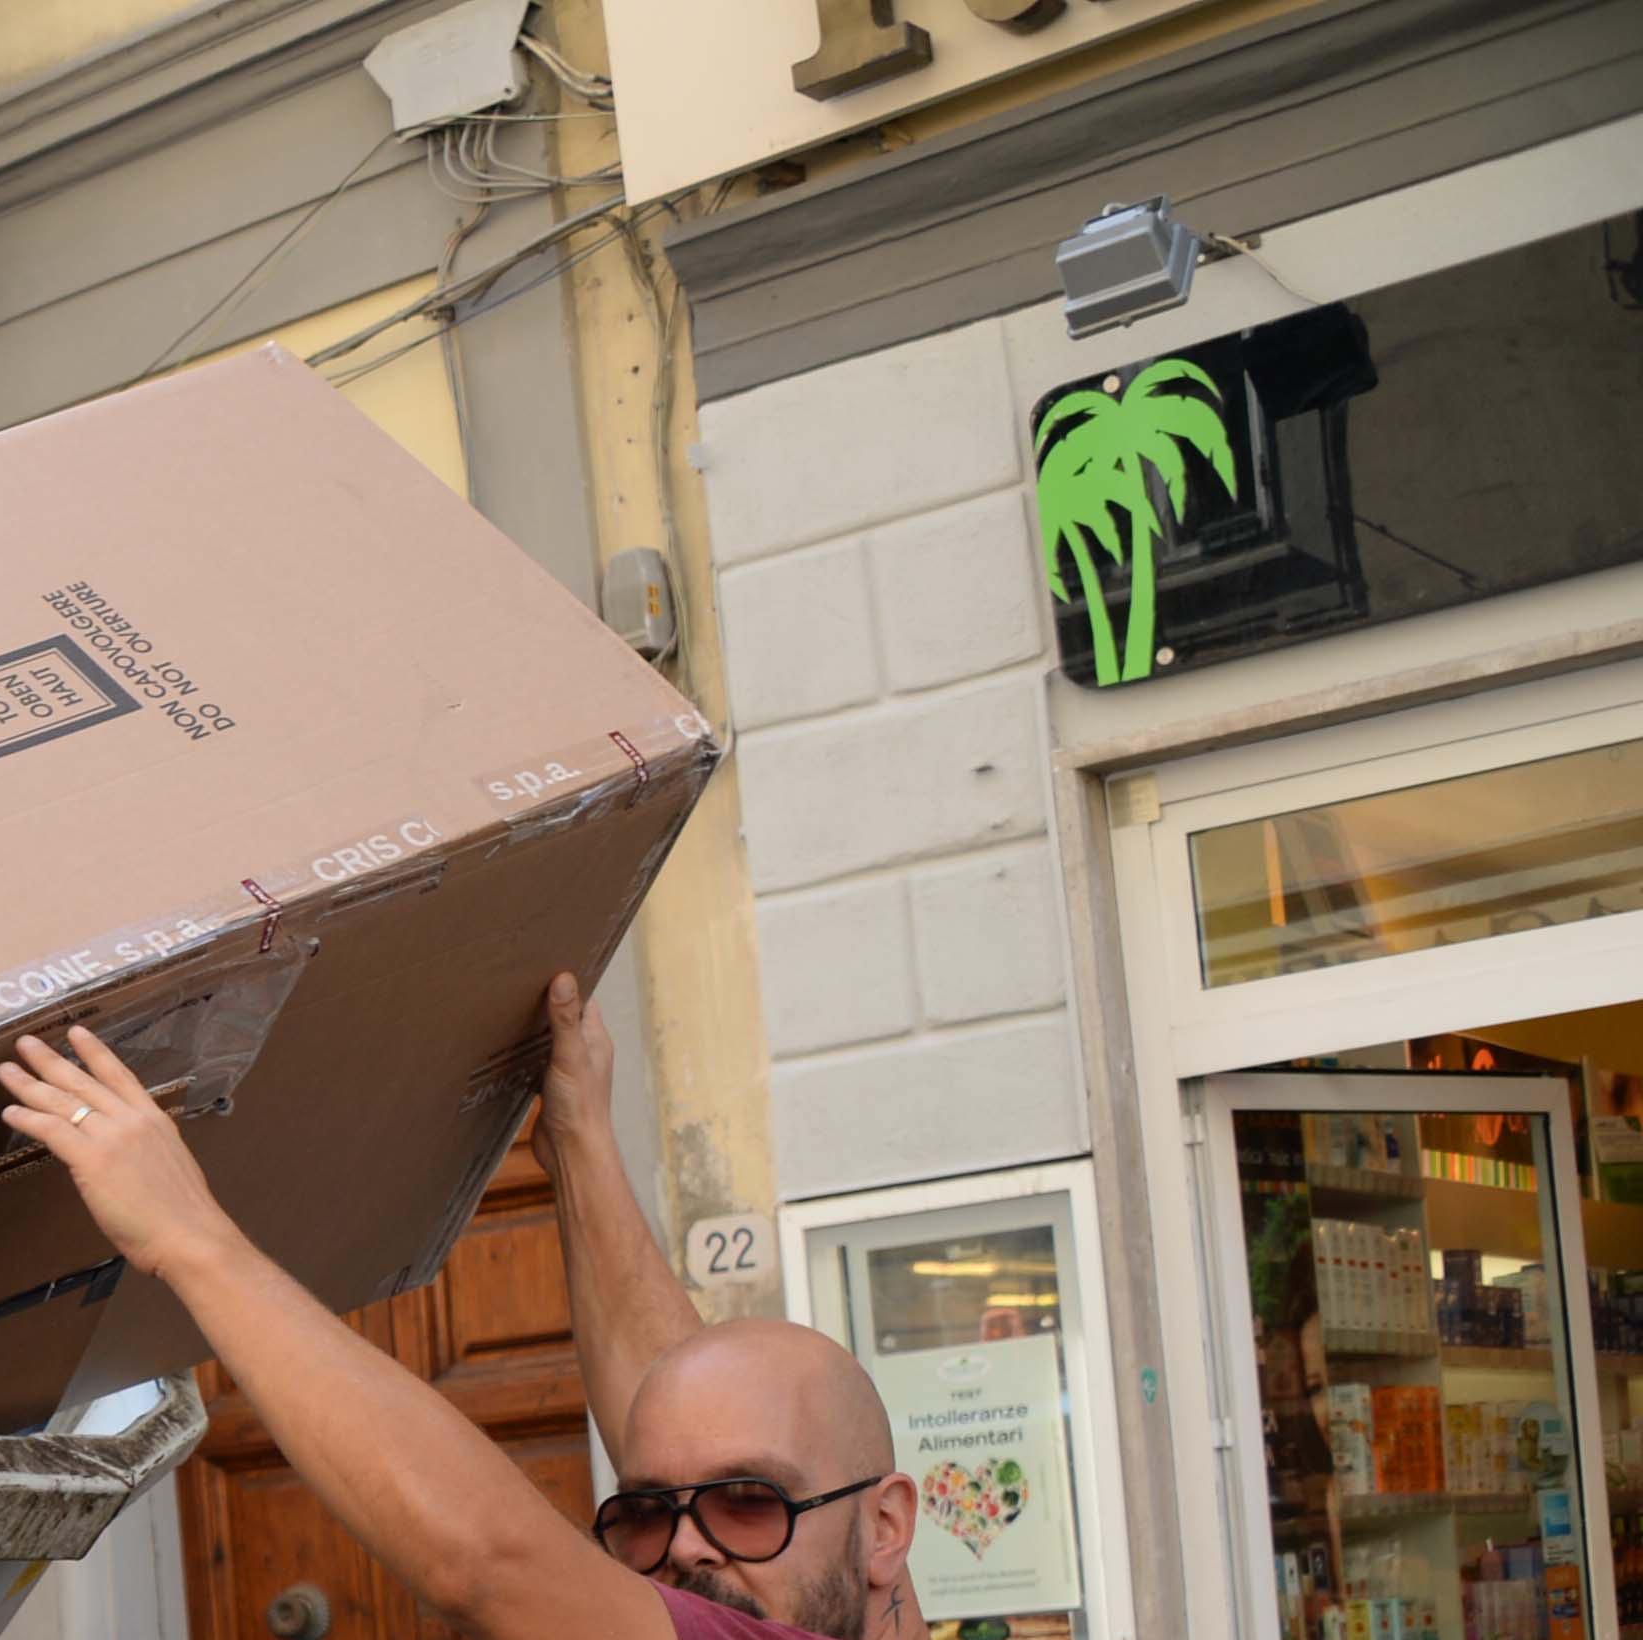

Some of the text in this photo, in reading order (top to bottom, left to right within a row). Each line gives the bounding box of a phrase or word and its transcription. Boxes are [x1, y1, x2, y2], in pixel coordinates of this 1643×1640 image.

[42, 589, 211, 741] NON CAPOVOLGERE
[66, 581, 236, 732] DO NOT OVERTURE
[0, 674, 53, 719] OBEN
[29, 667, 83, 707] HAUT
[487, 759, 582, 802] s.p.a.
[311, 833, 402, 884] CRIS
[114, 915, 226, 964] s.p.a.
[704, 1227, 756, 1275] 22
[908, 1403, 1029, 1430] Intolleranze
[918, 1427, 1024, 1453] Alimentari
